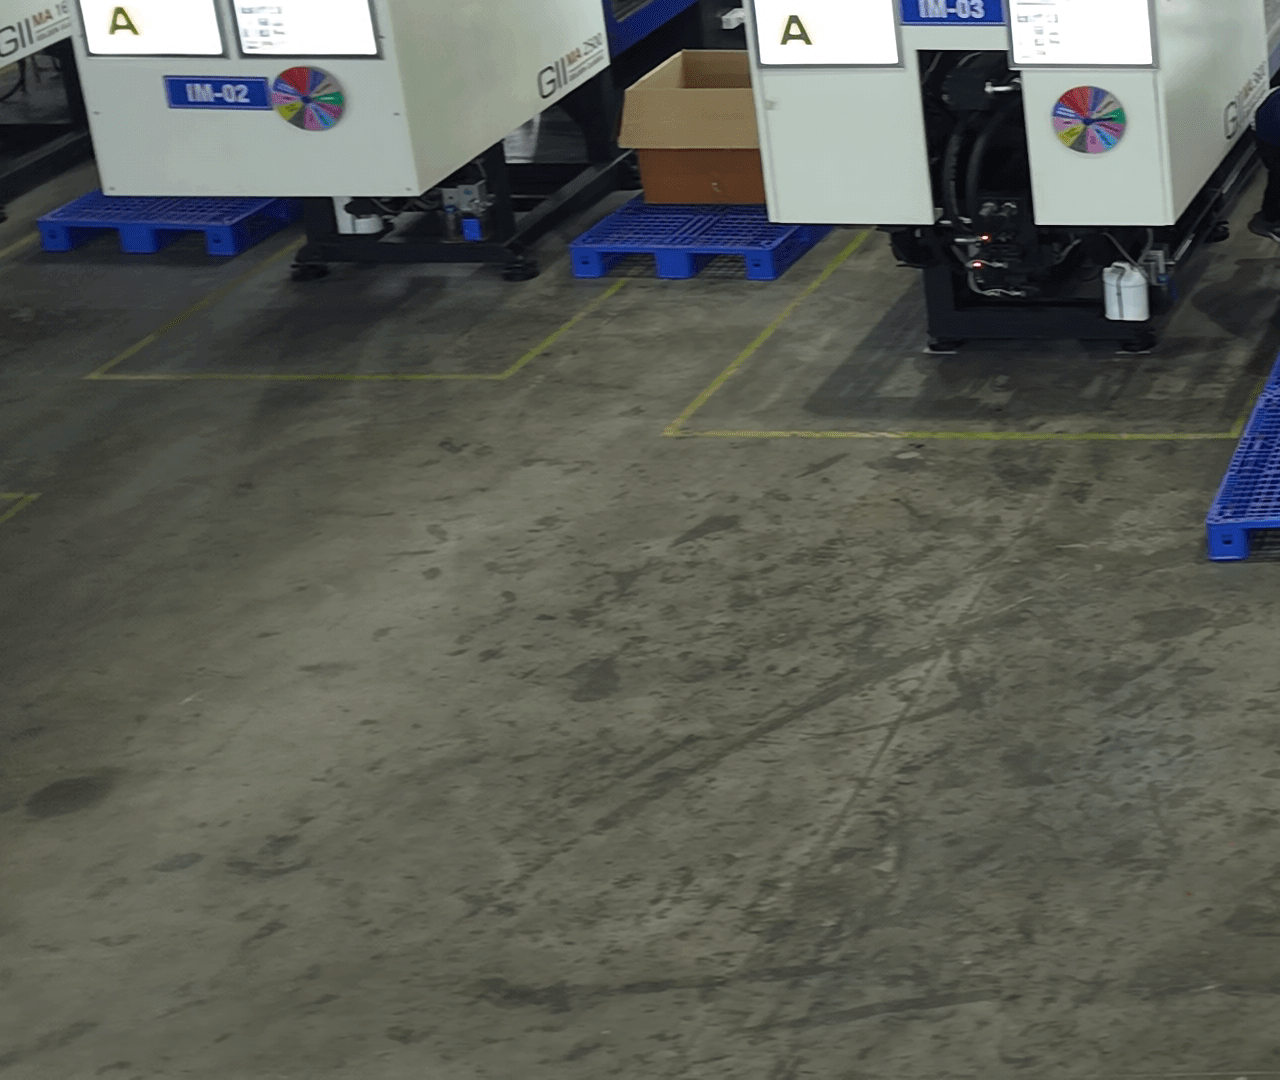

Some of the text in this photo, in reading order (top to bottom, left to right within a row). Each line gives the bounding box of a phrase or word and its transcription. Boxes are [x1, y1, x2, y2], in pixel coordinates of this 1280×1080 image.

[109, 6, 140, 35] A
[780, 14, 813, 46] A
[185, 83, 251, 104] IM-02
